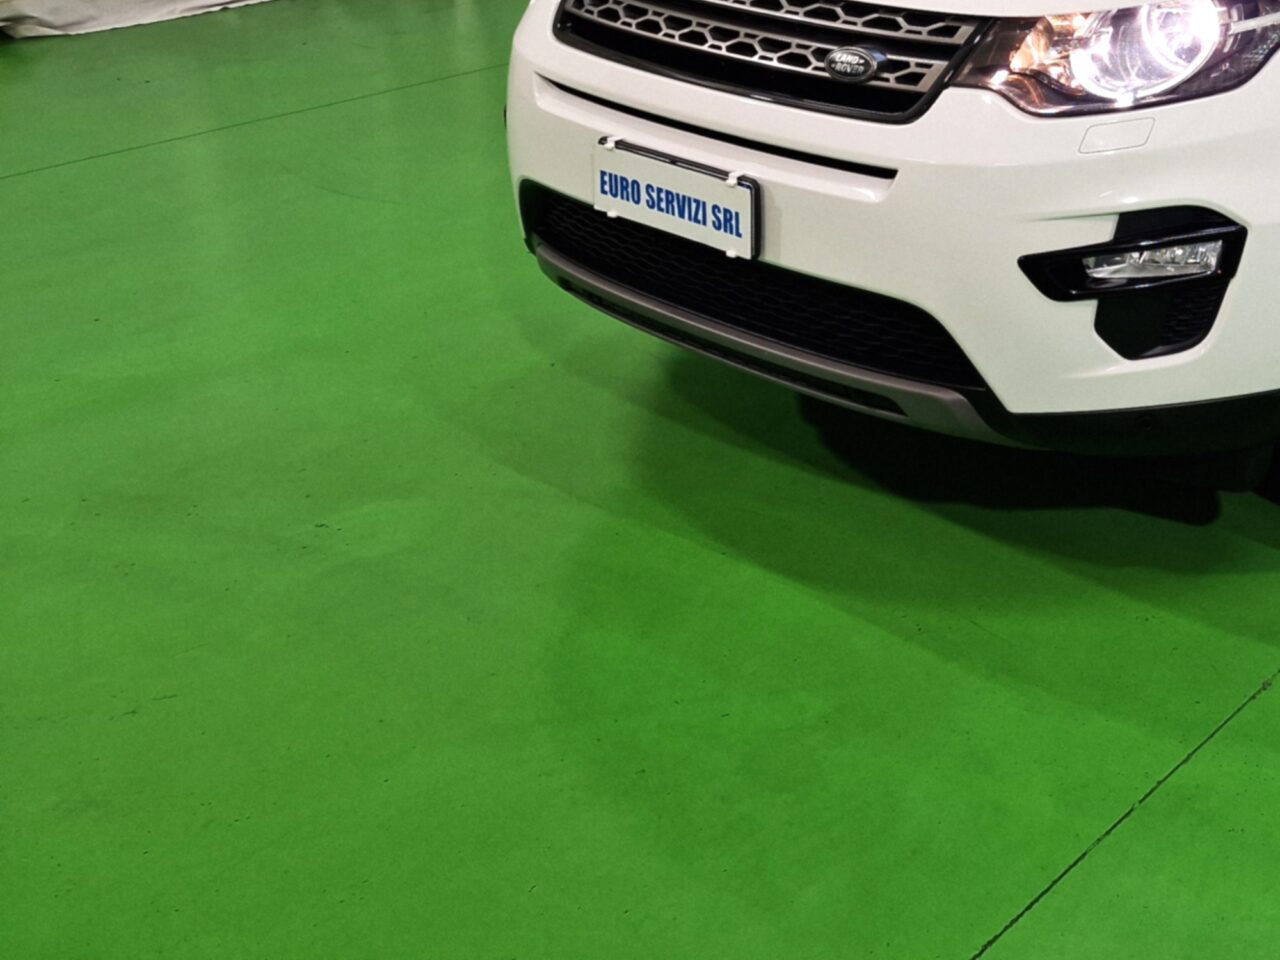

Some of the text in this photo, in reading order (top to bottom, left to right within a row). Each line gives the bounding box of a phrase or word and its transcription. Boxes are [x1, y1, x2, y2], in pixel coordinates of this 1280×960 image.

[836, 52, 859, 65] LAND
[600, 170, 743, 238] EURO SERVIZI SRL
